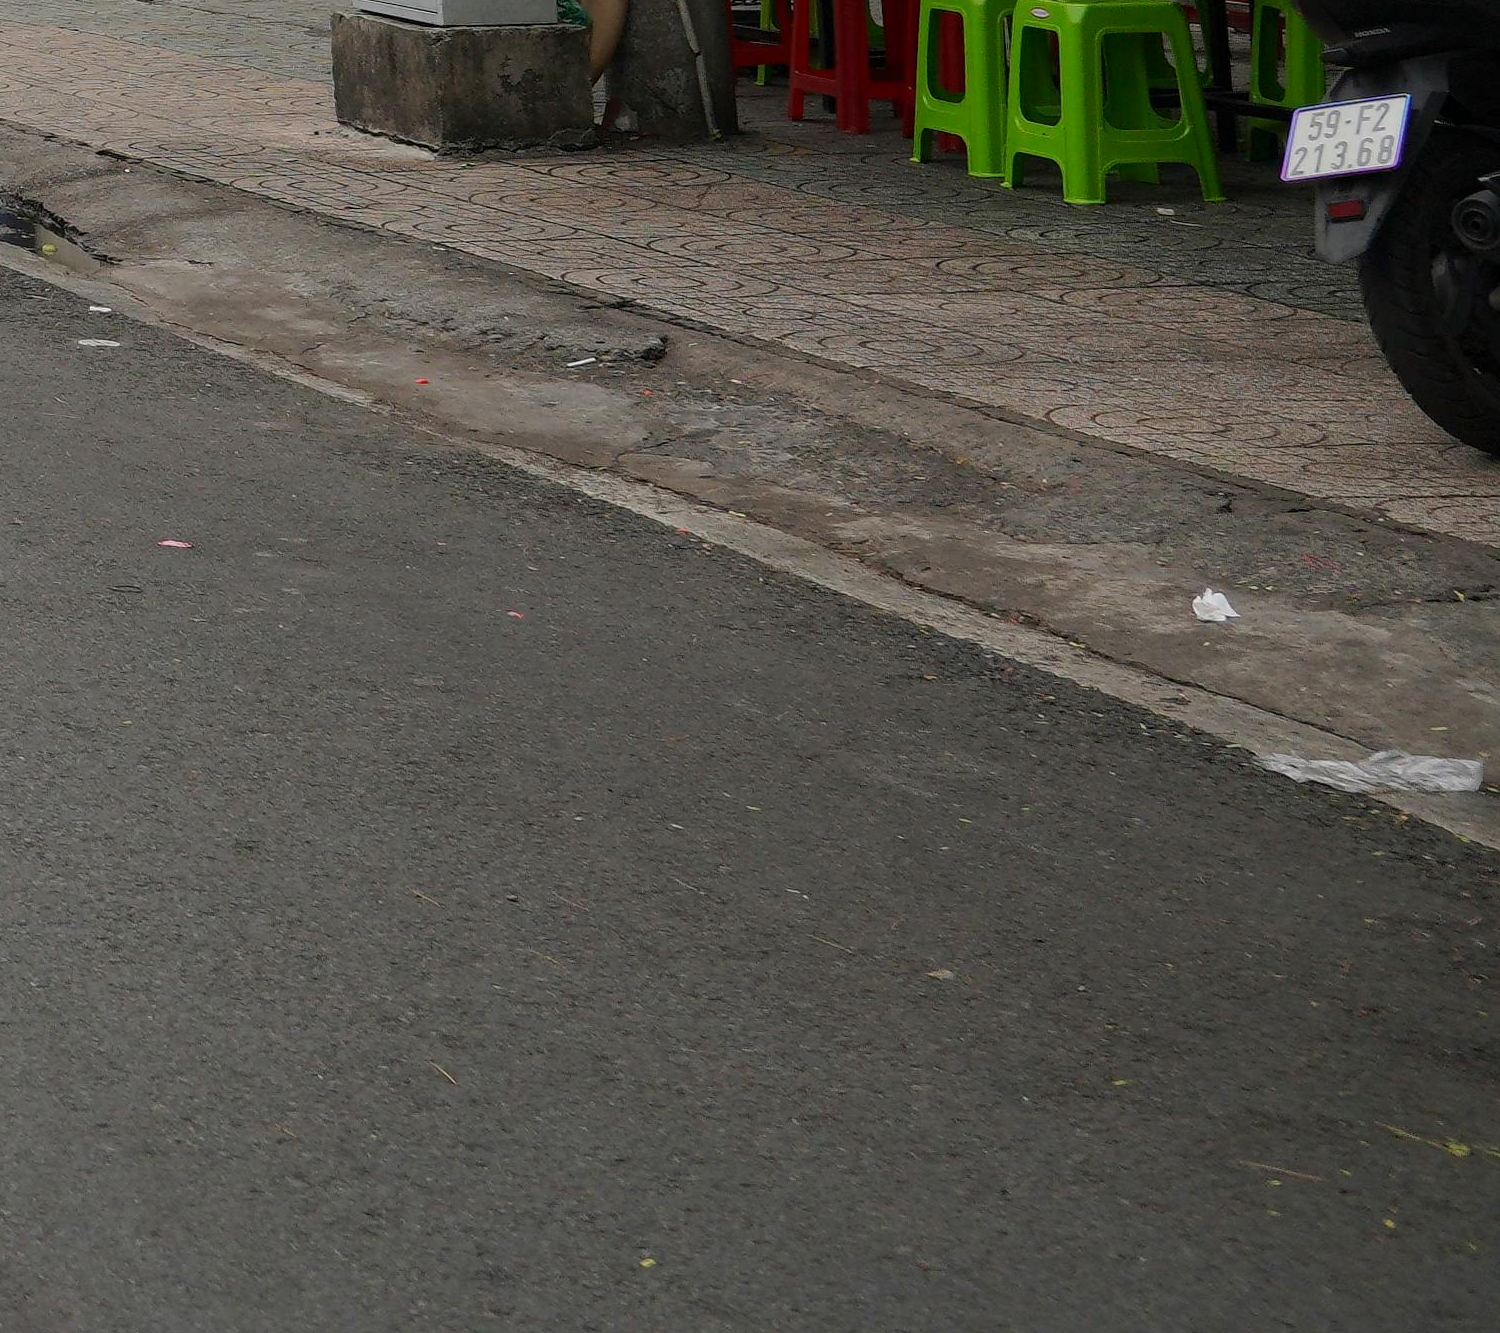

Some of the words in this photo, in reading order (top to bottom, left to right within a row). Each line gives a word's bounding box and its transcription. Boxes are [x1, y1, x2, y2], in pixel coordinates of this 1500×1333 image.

[1354, 27, 1391, 38] HONDA
[1307, 102, 1390, 141] 59-F2
[1289, 134, 1395, 176] 213.68
